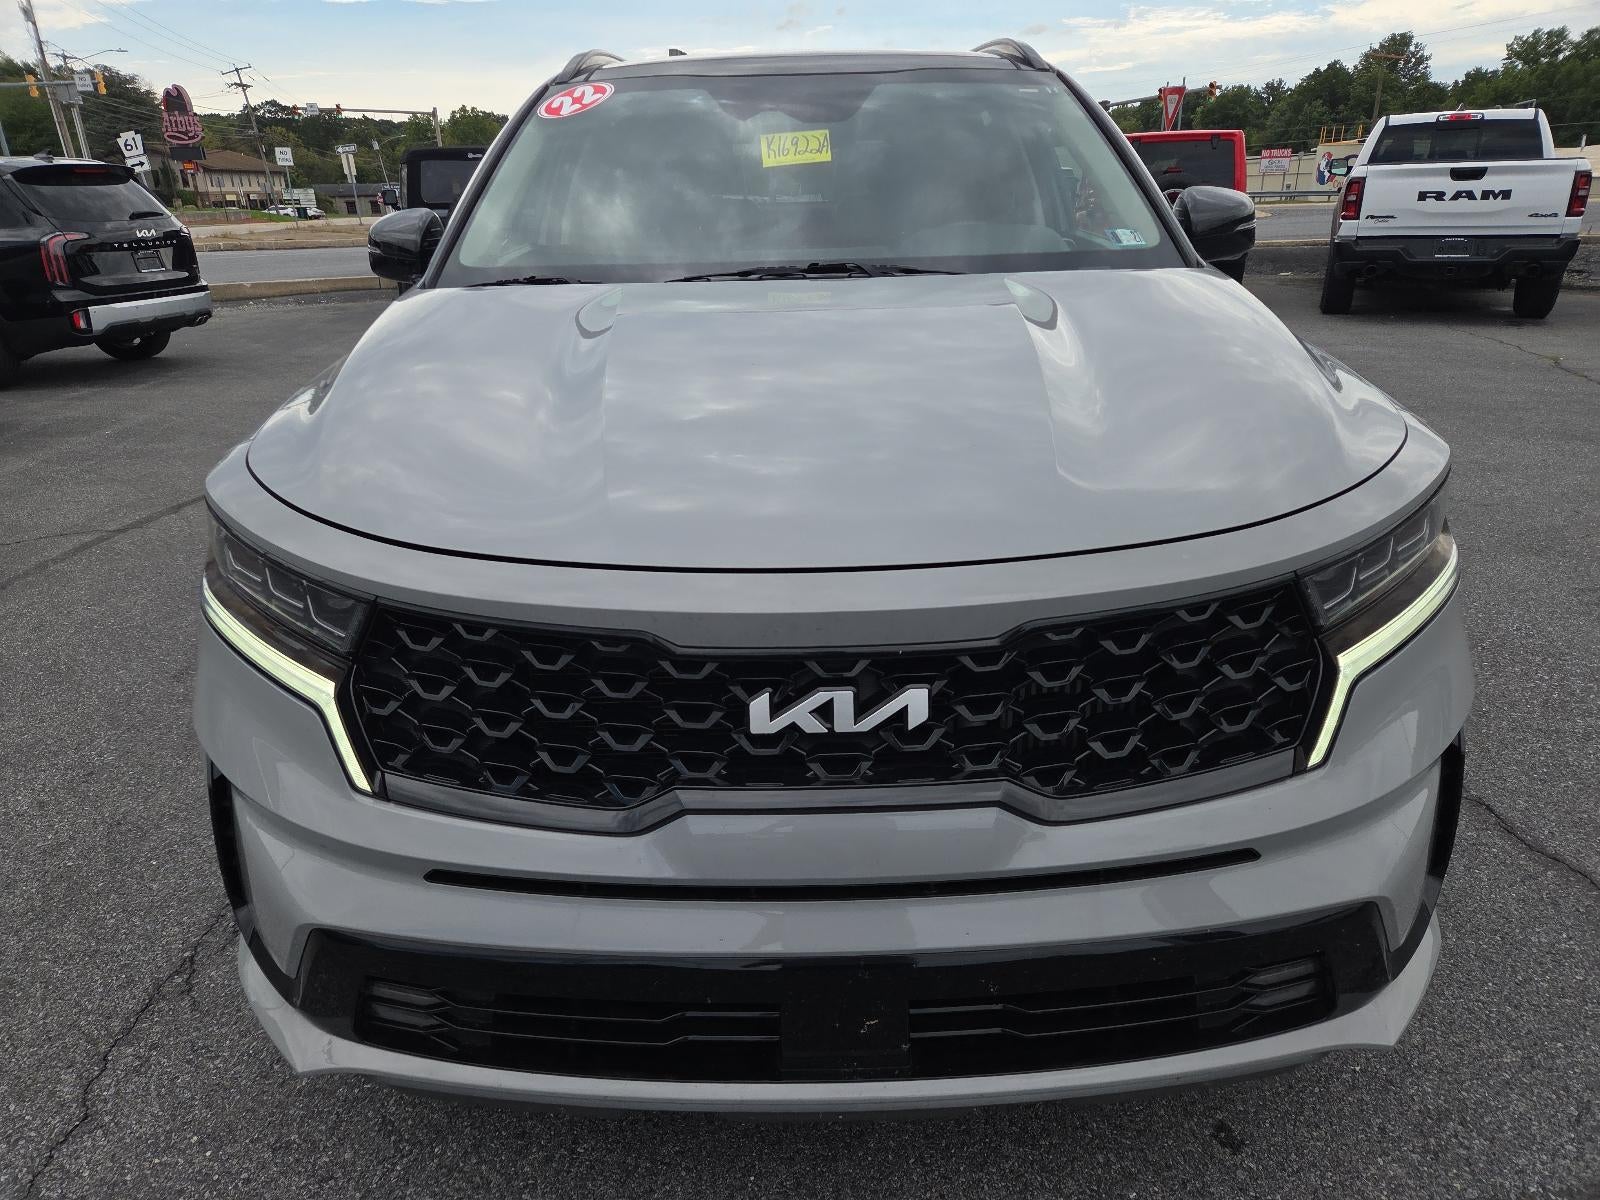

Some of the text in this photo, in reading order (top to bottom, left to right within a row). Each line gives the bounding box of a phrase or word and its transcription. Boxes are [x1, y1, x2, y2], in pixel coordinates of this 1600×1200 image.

[551, 82, 602, 116] 22
[123, 136, 139, 152] 61
[765, 132, 830, 159] K16922A
[1261, 148, 1292, 157] NO TRUCKS
[1416, 189, 1513, 202] RAM
[135, 228, 157, 238] KIA
[113, 240, 178, 249] TELLURIDE
[749, 688, 929, 735] KIA
